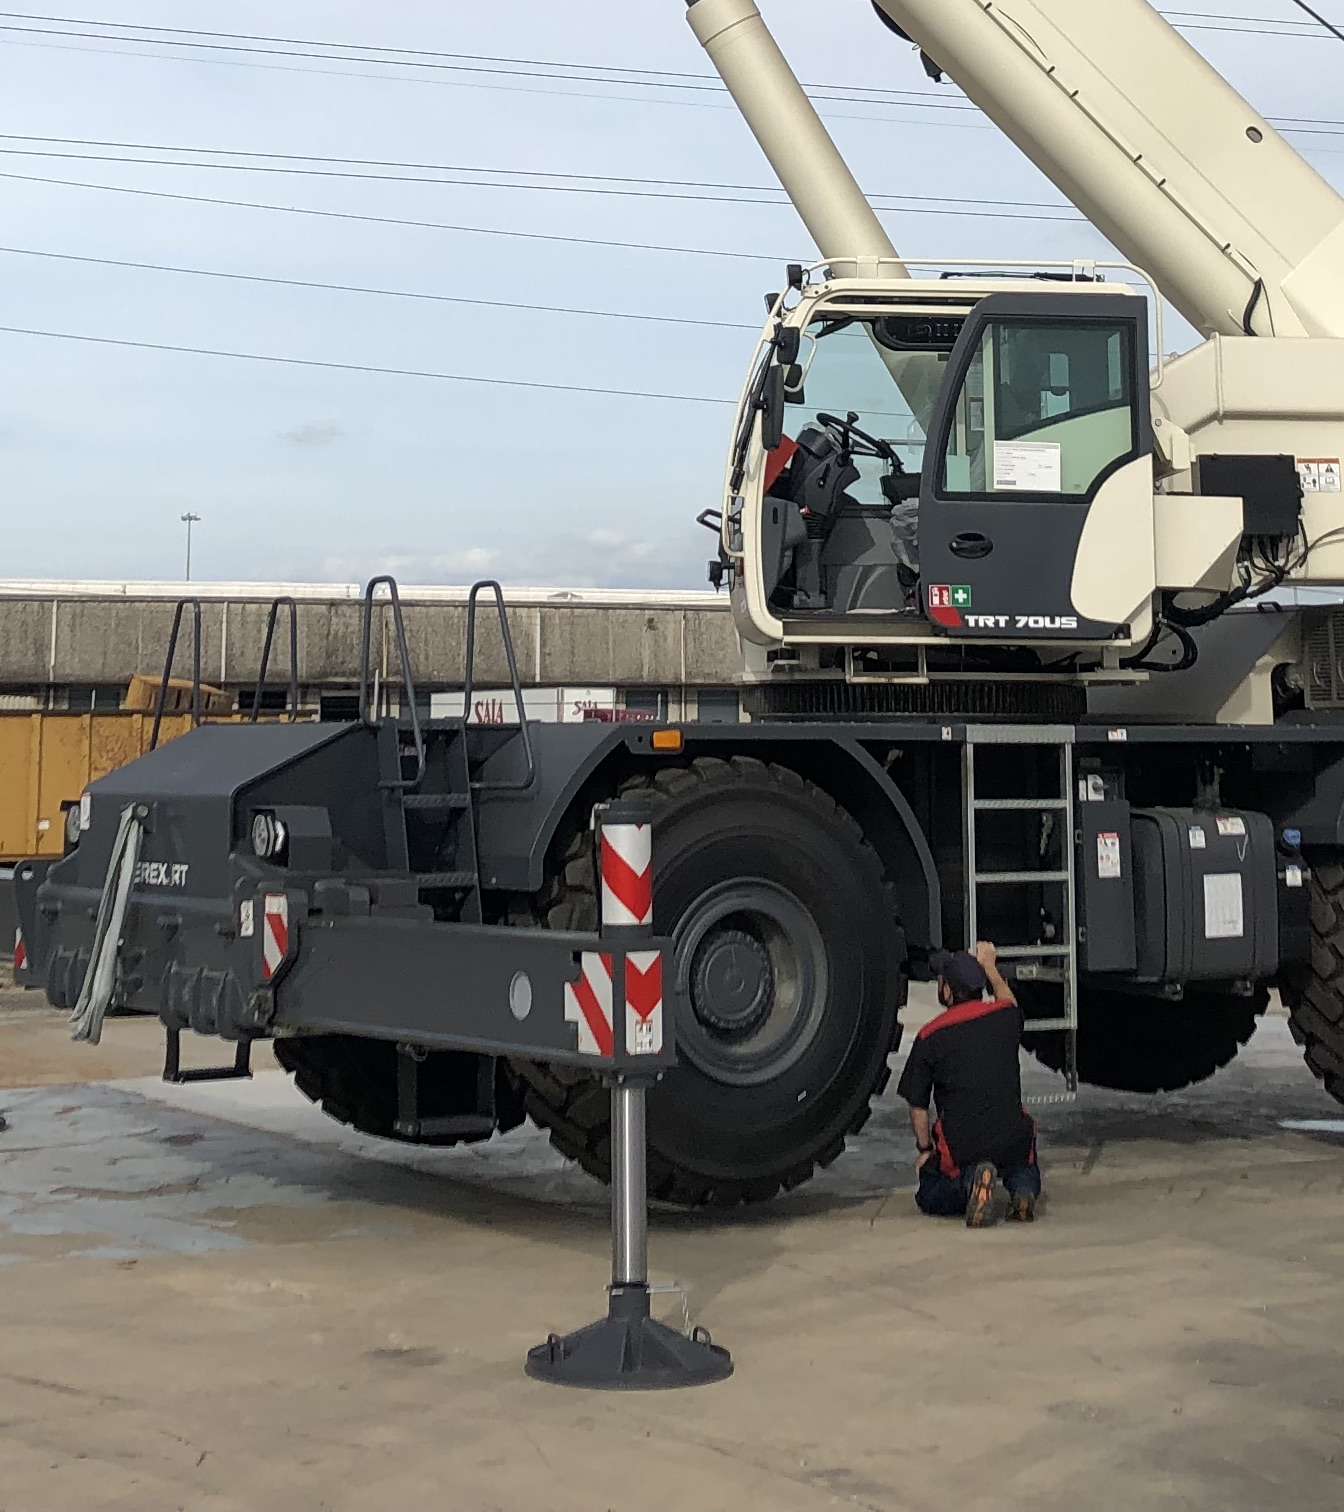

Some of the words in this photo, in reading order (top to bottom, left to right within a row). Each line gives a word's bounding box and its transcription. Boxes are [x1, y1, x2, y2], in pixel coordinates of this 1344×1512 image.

[964, 614, 1010, 628] TRT
[1015, 615, 1078, 629] 70US
[474, 698, 504, 725] SAIA
